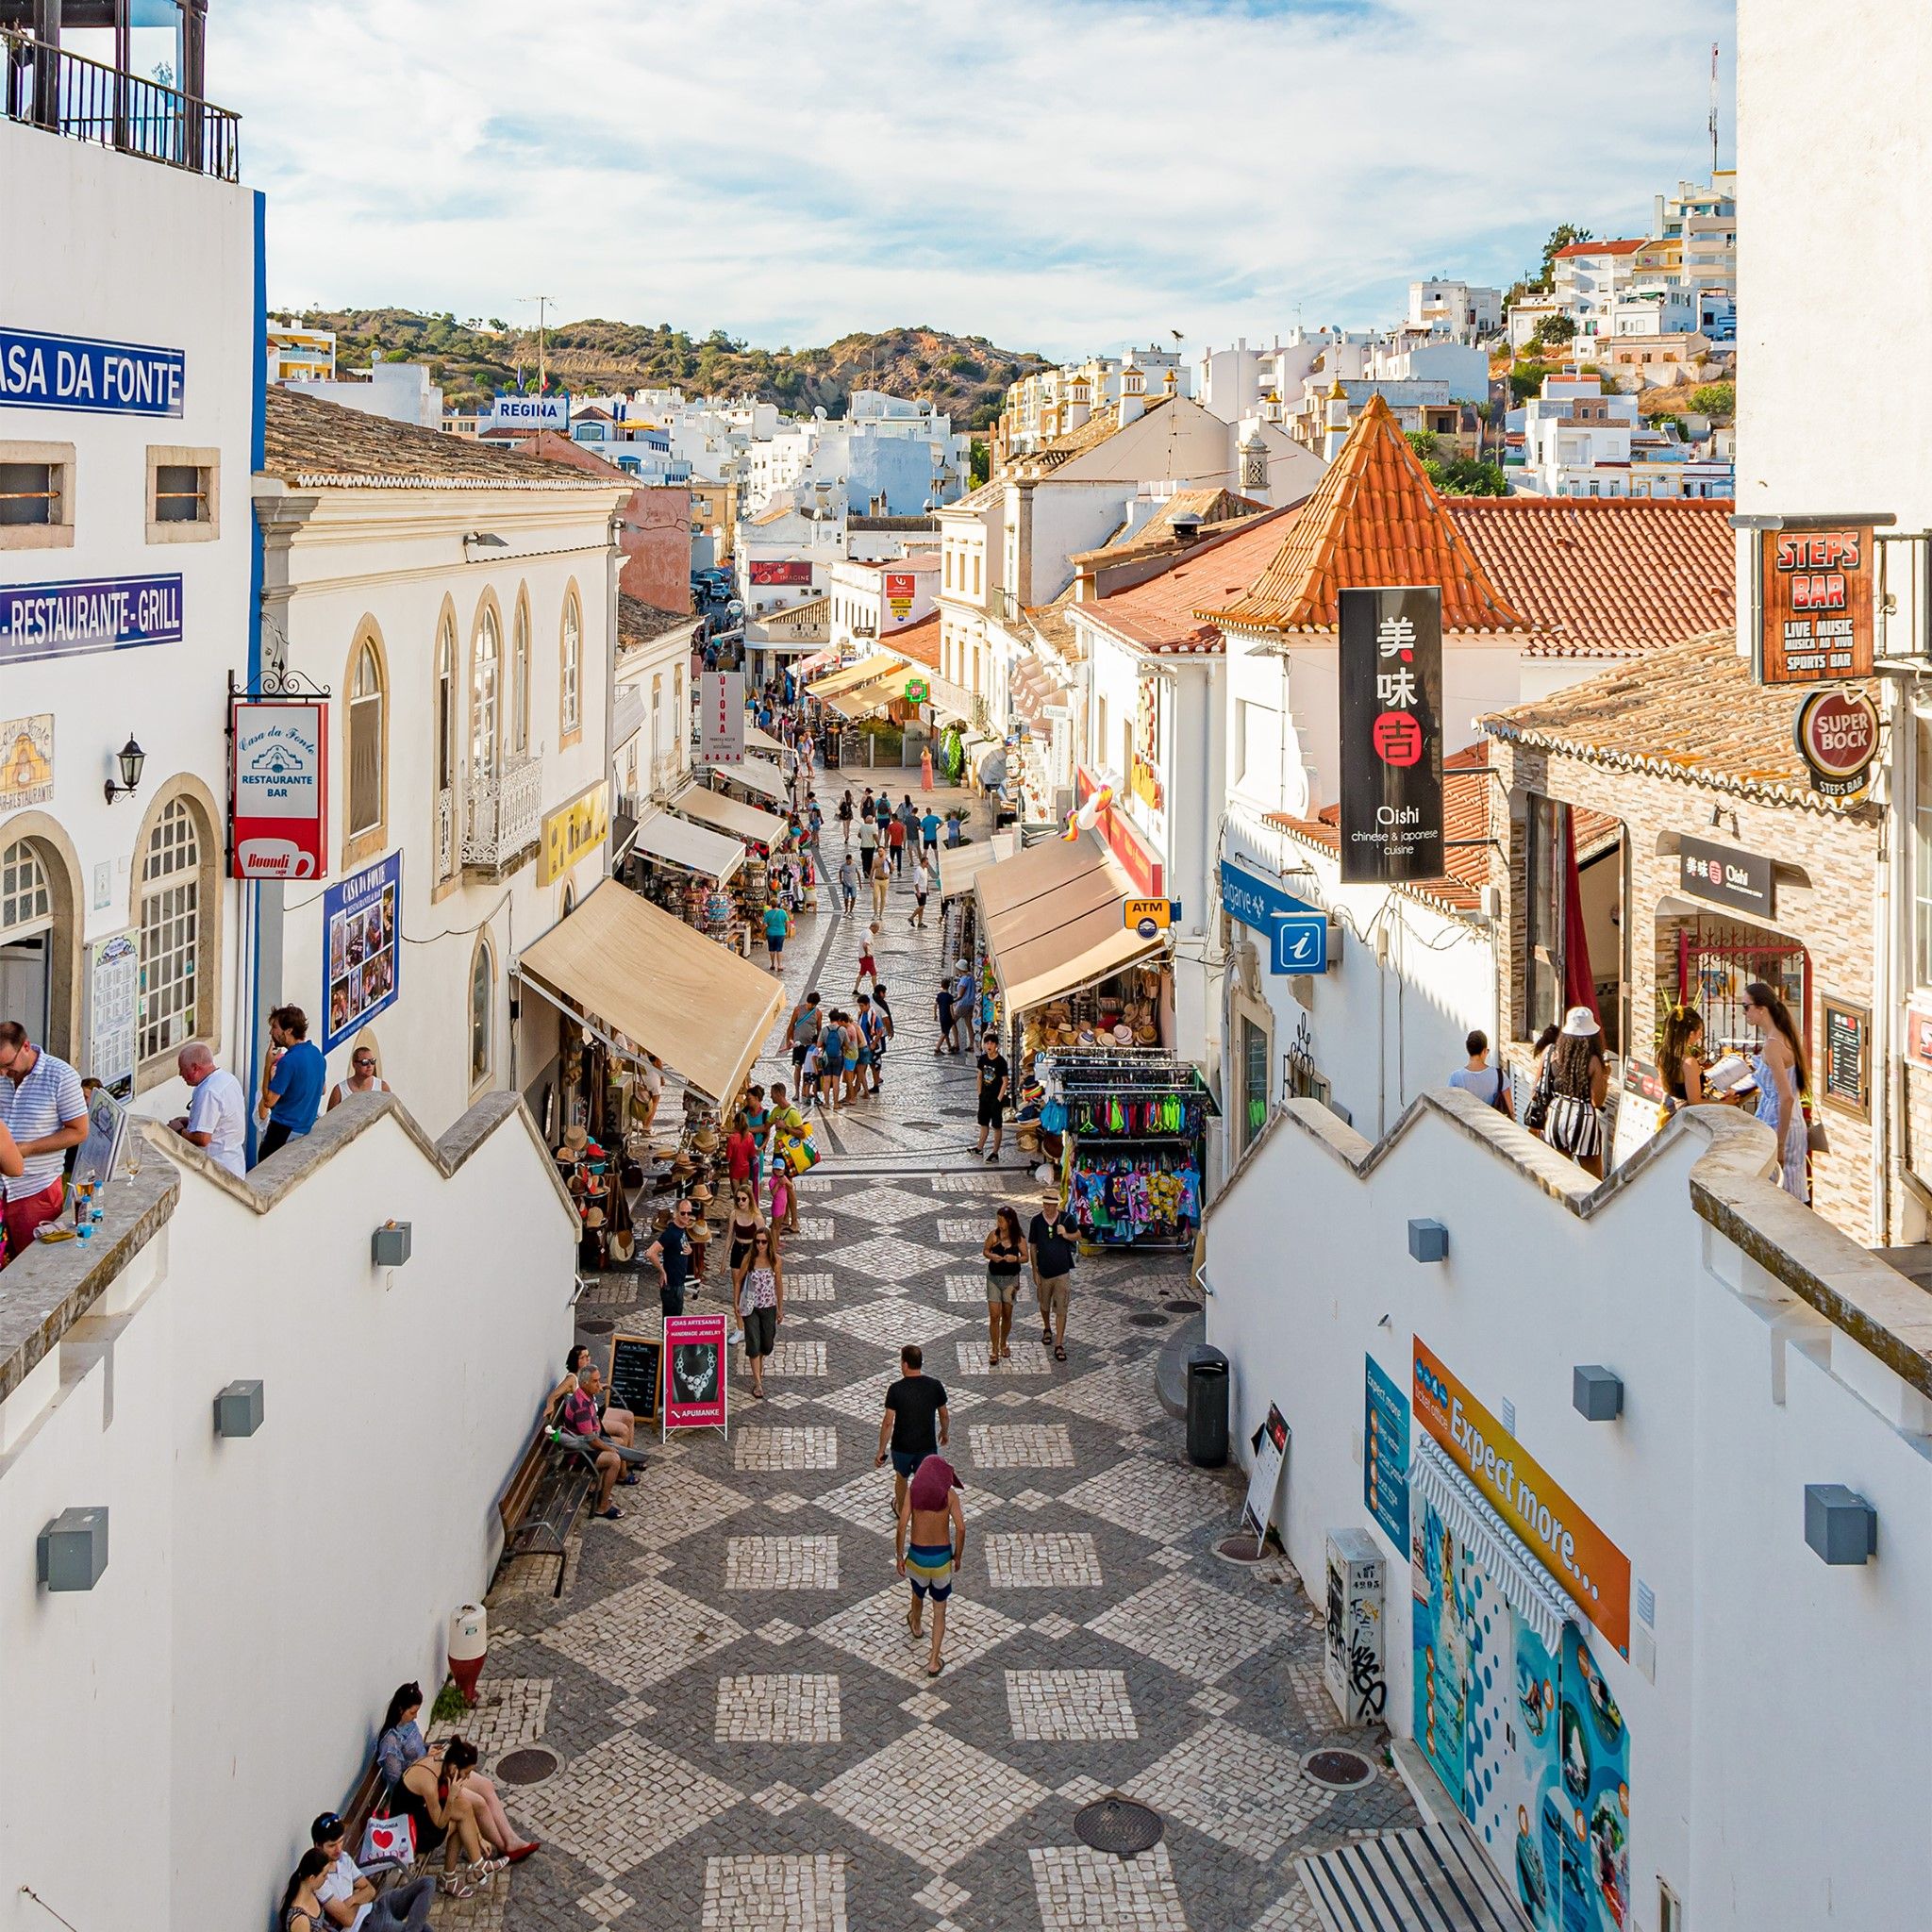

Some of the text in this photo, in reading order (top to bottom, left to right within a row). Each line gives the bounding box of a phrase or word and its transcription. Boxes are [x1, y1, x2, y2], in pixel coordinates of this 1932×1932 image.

[57, 350, 94, 399] DA
[103, 355, 182, 406] FONTE
[501, 404, 558, 418] REGINA
[1777, 531, 1859, 571] STEPS
[1792, 575, 1845, 610] BAR
[1784, 619, 1854, 639] LIVE MUSIC
[1819, 637, 1831, 649] AO
[1834, 636, 1854, 648] VIVO
[1787, 653, 1851, 671] SPORTS BAR
[1817, 712, 1869, 734] SUPER
[239, 725, 315, 756] Casa da Fonte
[1822, 729, 1868, 751] BOCK
[242, 774, 313, 786] RESTAURANTE
[1819, 775, 1864, 795] STEPS BAR
[267, 789, 288, 798] BAR
[1376, 805, 1420, 825] Oishi
[1351, 829, 1439, 842] chinese & japanese
[1383, 844, 1415, 857] cuisine
[342, 877, 358, 905] CASA
[1223, 873, 1252, 914] algarve
[1132, 902, 1163, 913] ATM
[1367, 1370, 1386, 1402] Expect
[681, 1408, 720, 1419] APUMANKE
[1450, 1395, 1600, 1602] Expect more...
